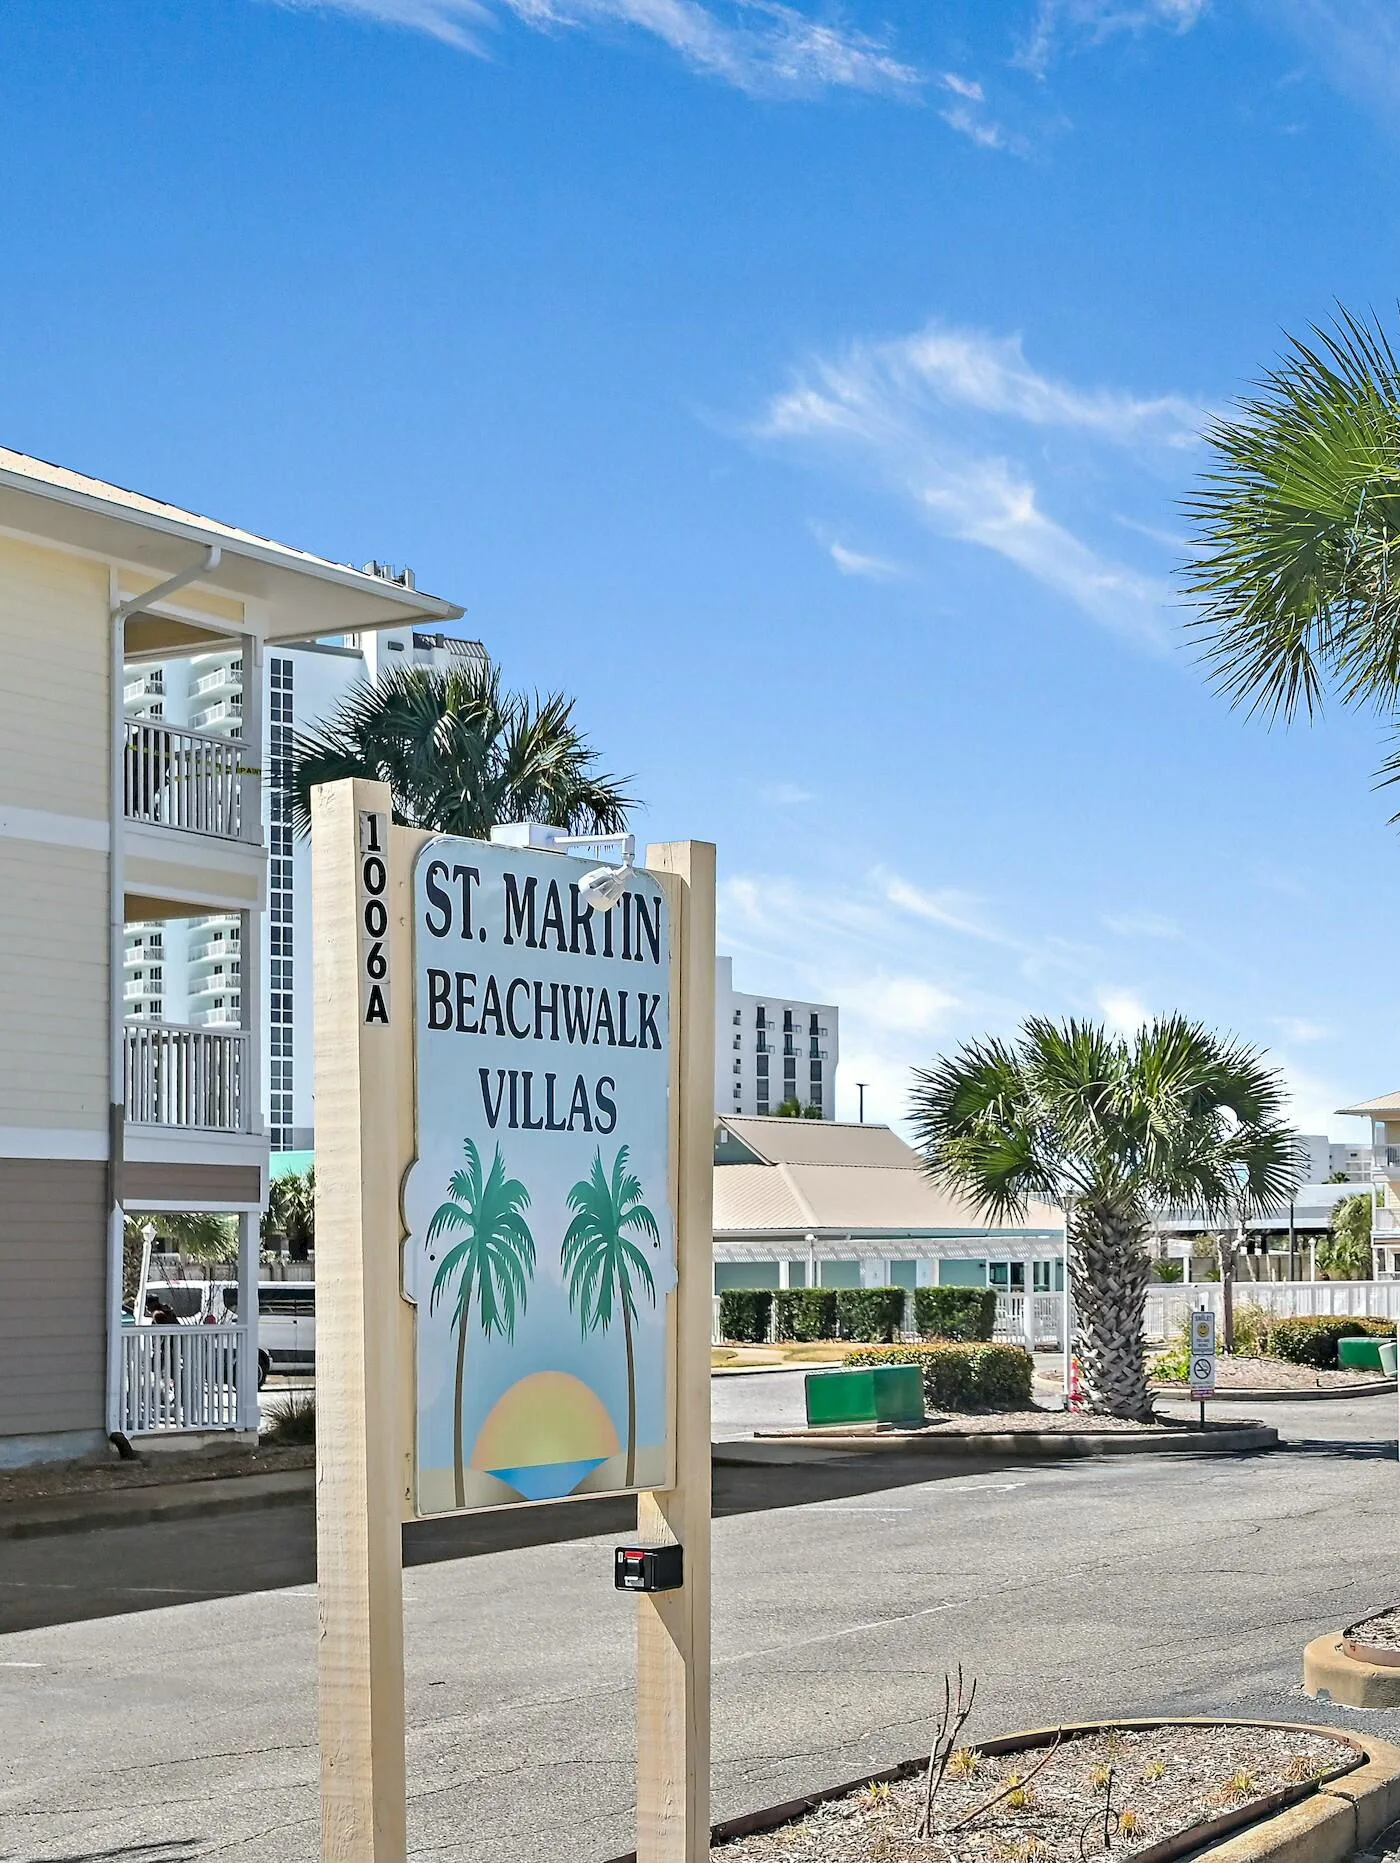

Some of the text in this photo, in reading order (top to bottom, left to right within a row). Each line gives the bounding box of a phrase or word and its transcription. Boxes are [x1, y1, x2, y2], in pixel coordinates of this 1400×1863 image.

[425, 860, 662, 964] ST. MARTIN
[426, 967, 663, 1050] BEACHWALK
[478, 1067, 617, 1135] VILLAS
